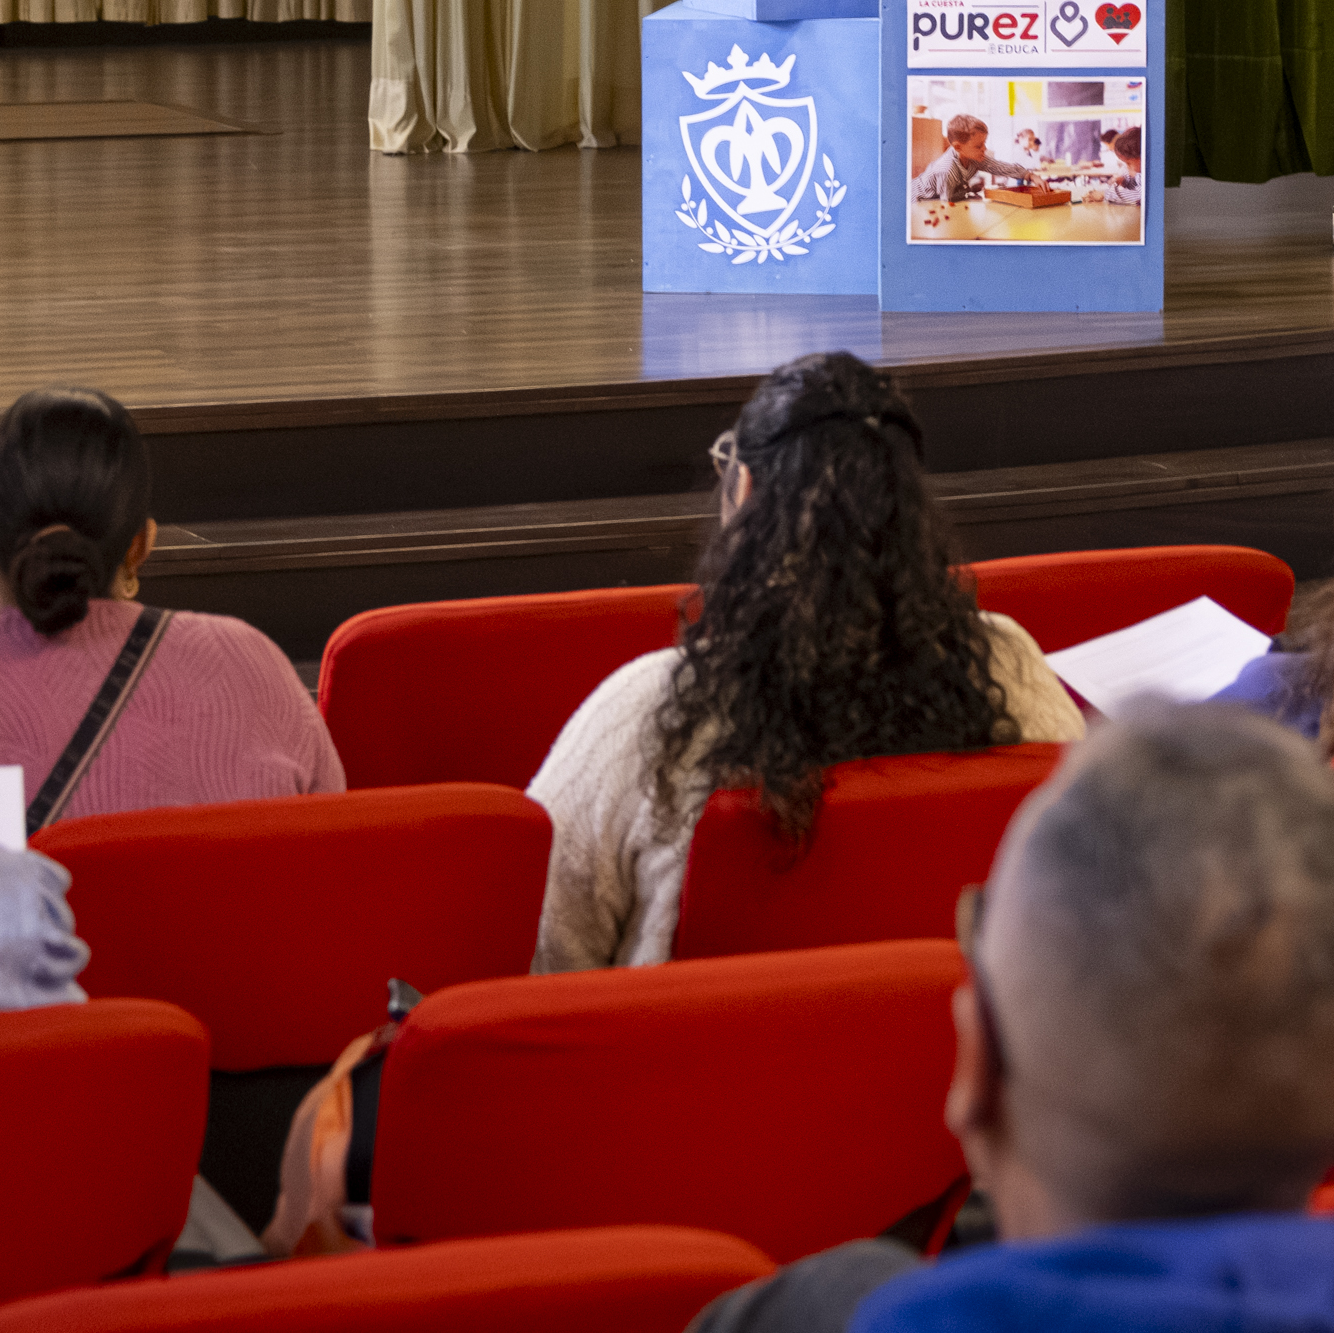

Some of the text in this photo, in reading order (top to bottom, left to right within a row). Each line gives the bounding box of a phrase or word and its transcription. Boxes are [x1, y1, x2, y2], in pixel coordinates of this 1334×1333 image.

[918, 0, 965, 8] LA CUESTA
[997, 44, 1040, 54] EDUCA
